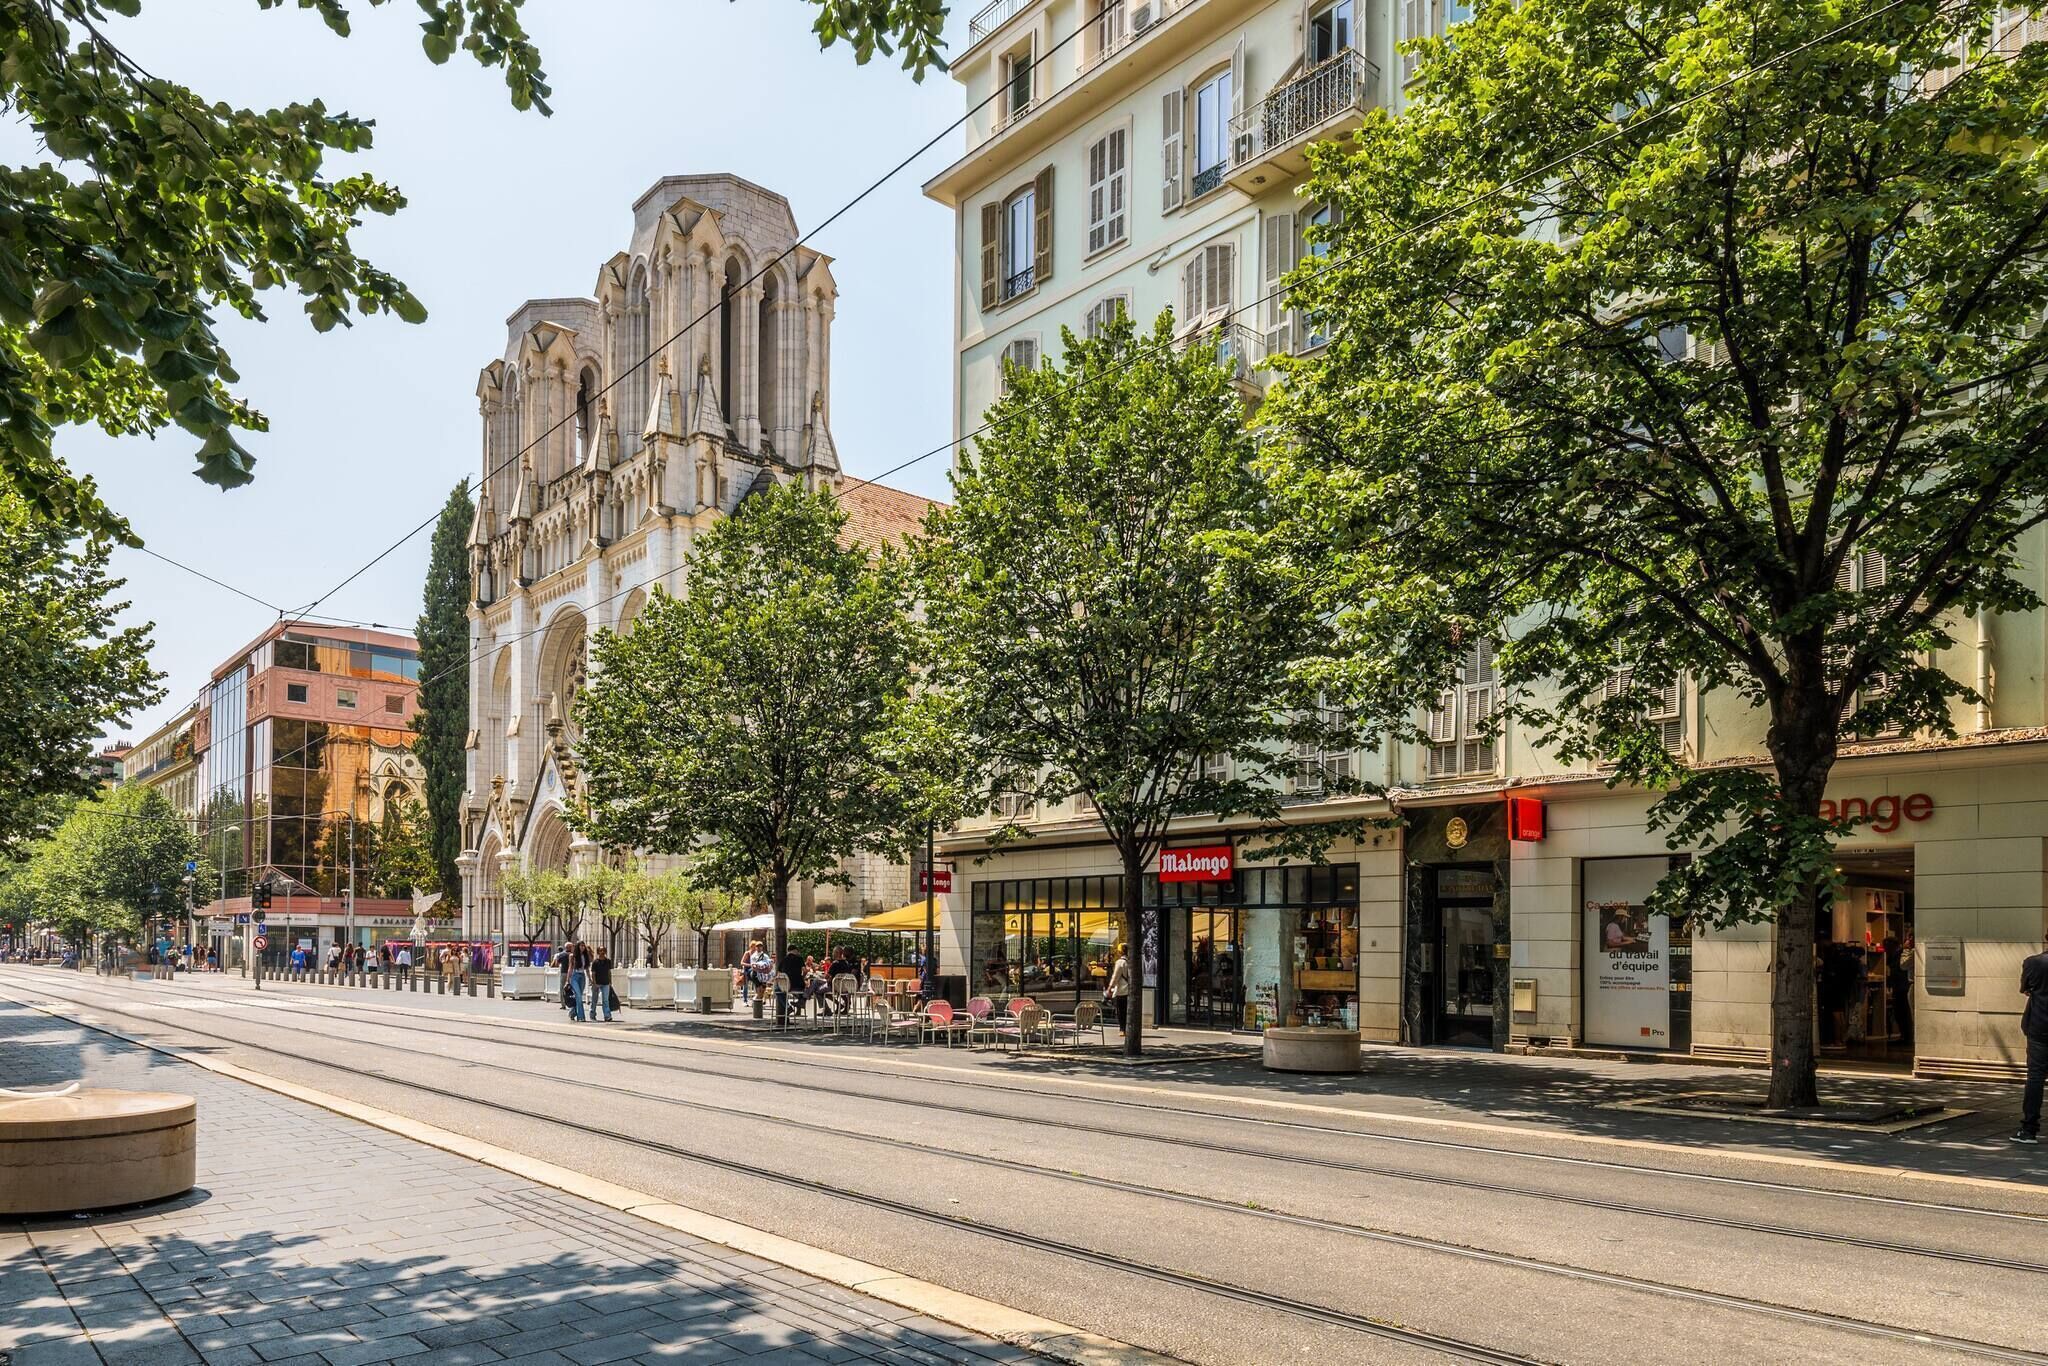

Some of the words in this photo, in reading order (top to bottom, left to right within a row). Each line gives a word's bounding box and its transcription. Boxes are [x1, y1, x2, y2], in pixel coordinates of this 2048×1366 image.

[1756, 793, 1934, 833] ange
[1522, 829, 1541, 839] orange
[1161, 853, 1229, 876] Malongo
[922, 877, 951, 888] Mlongo
[1586, 900, 1600, 912] Ça
[1603, 900, 1629, 911] c'est
[1609, 950, 1622, 959] du
[1626, 949, 1659, 959] travail
[1612, 960, 1659, 972] d'équipe
